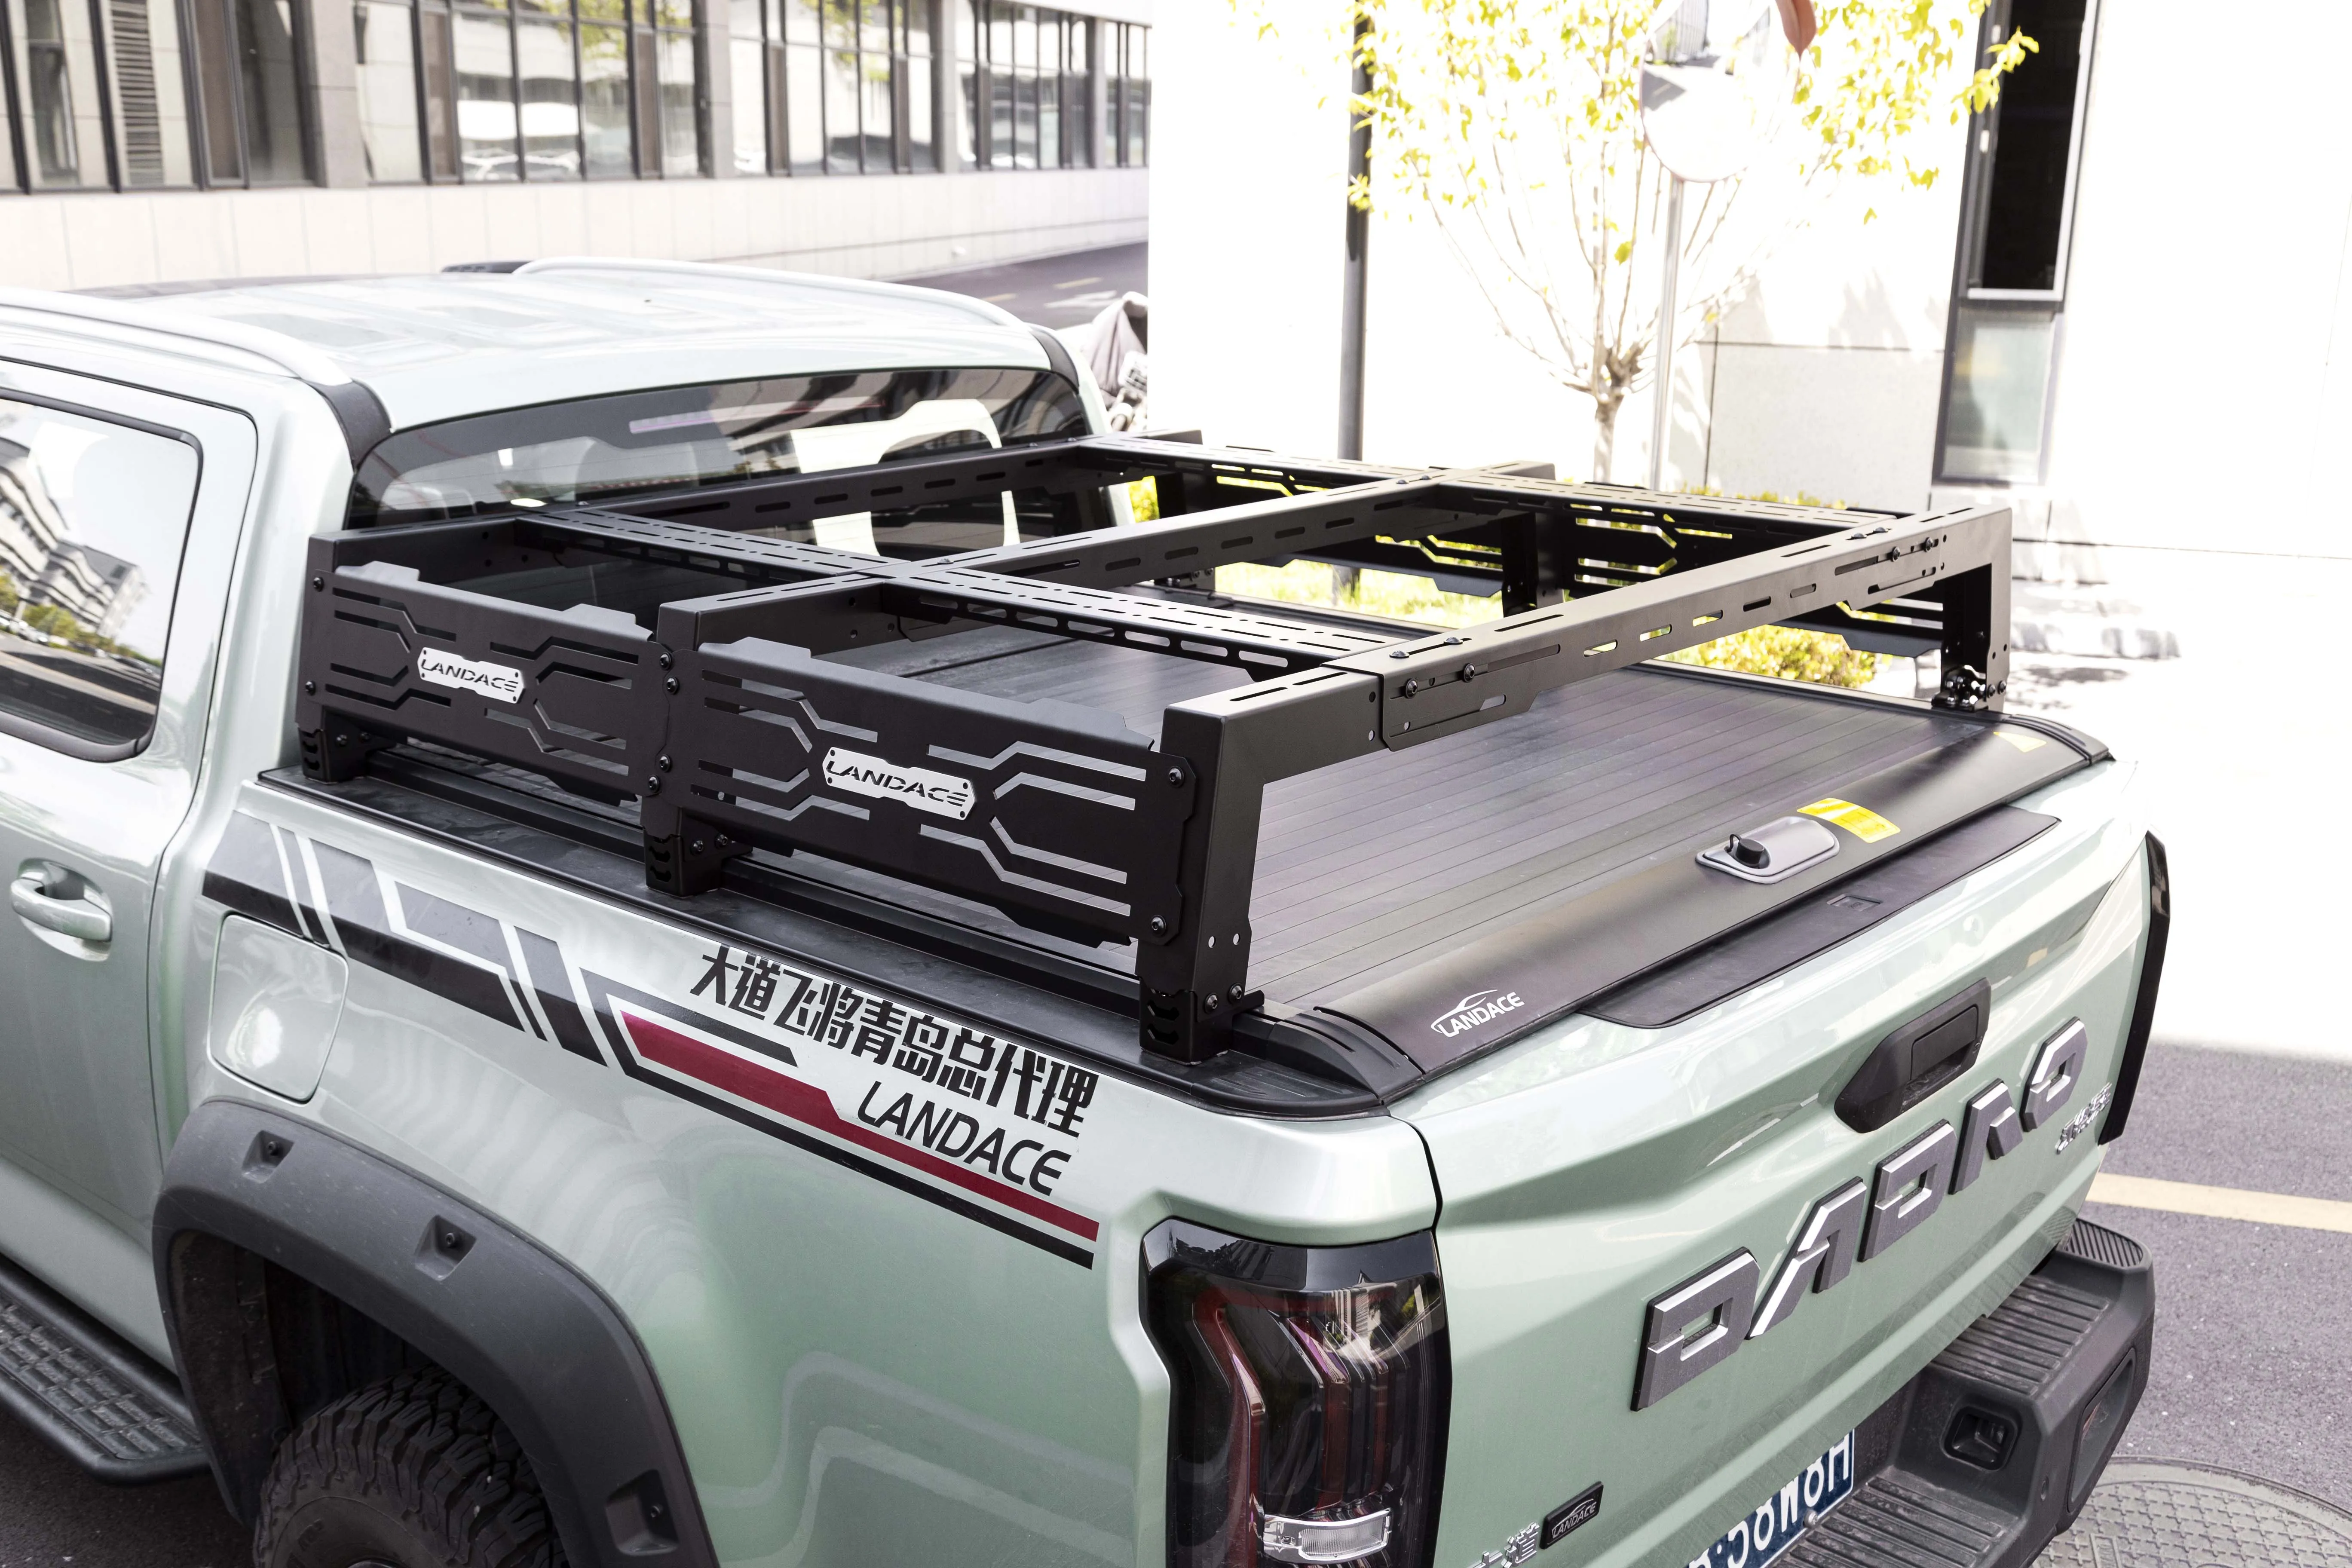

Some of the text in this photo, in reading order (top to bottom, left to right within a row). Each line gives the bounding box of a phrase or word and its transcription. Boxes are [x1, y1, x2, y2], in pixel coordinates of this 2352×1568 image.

[421, 659, 518, 692] LANDACE
[826, 760, 968, 807] LANDACE
[1437, 992, 1525, 1038] LANDACE
[690, 945, 1099, 1138] 大道飞将青岛总代理
[857, 1081, 1071, 1196] LANDACE
[1553, 1501, 1597, 1539] LANDACE
